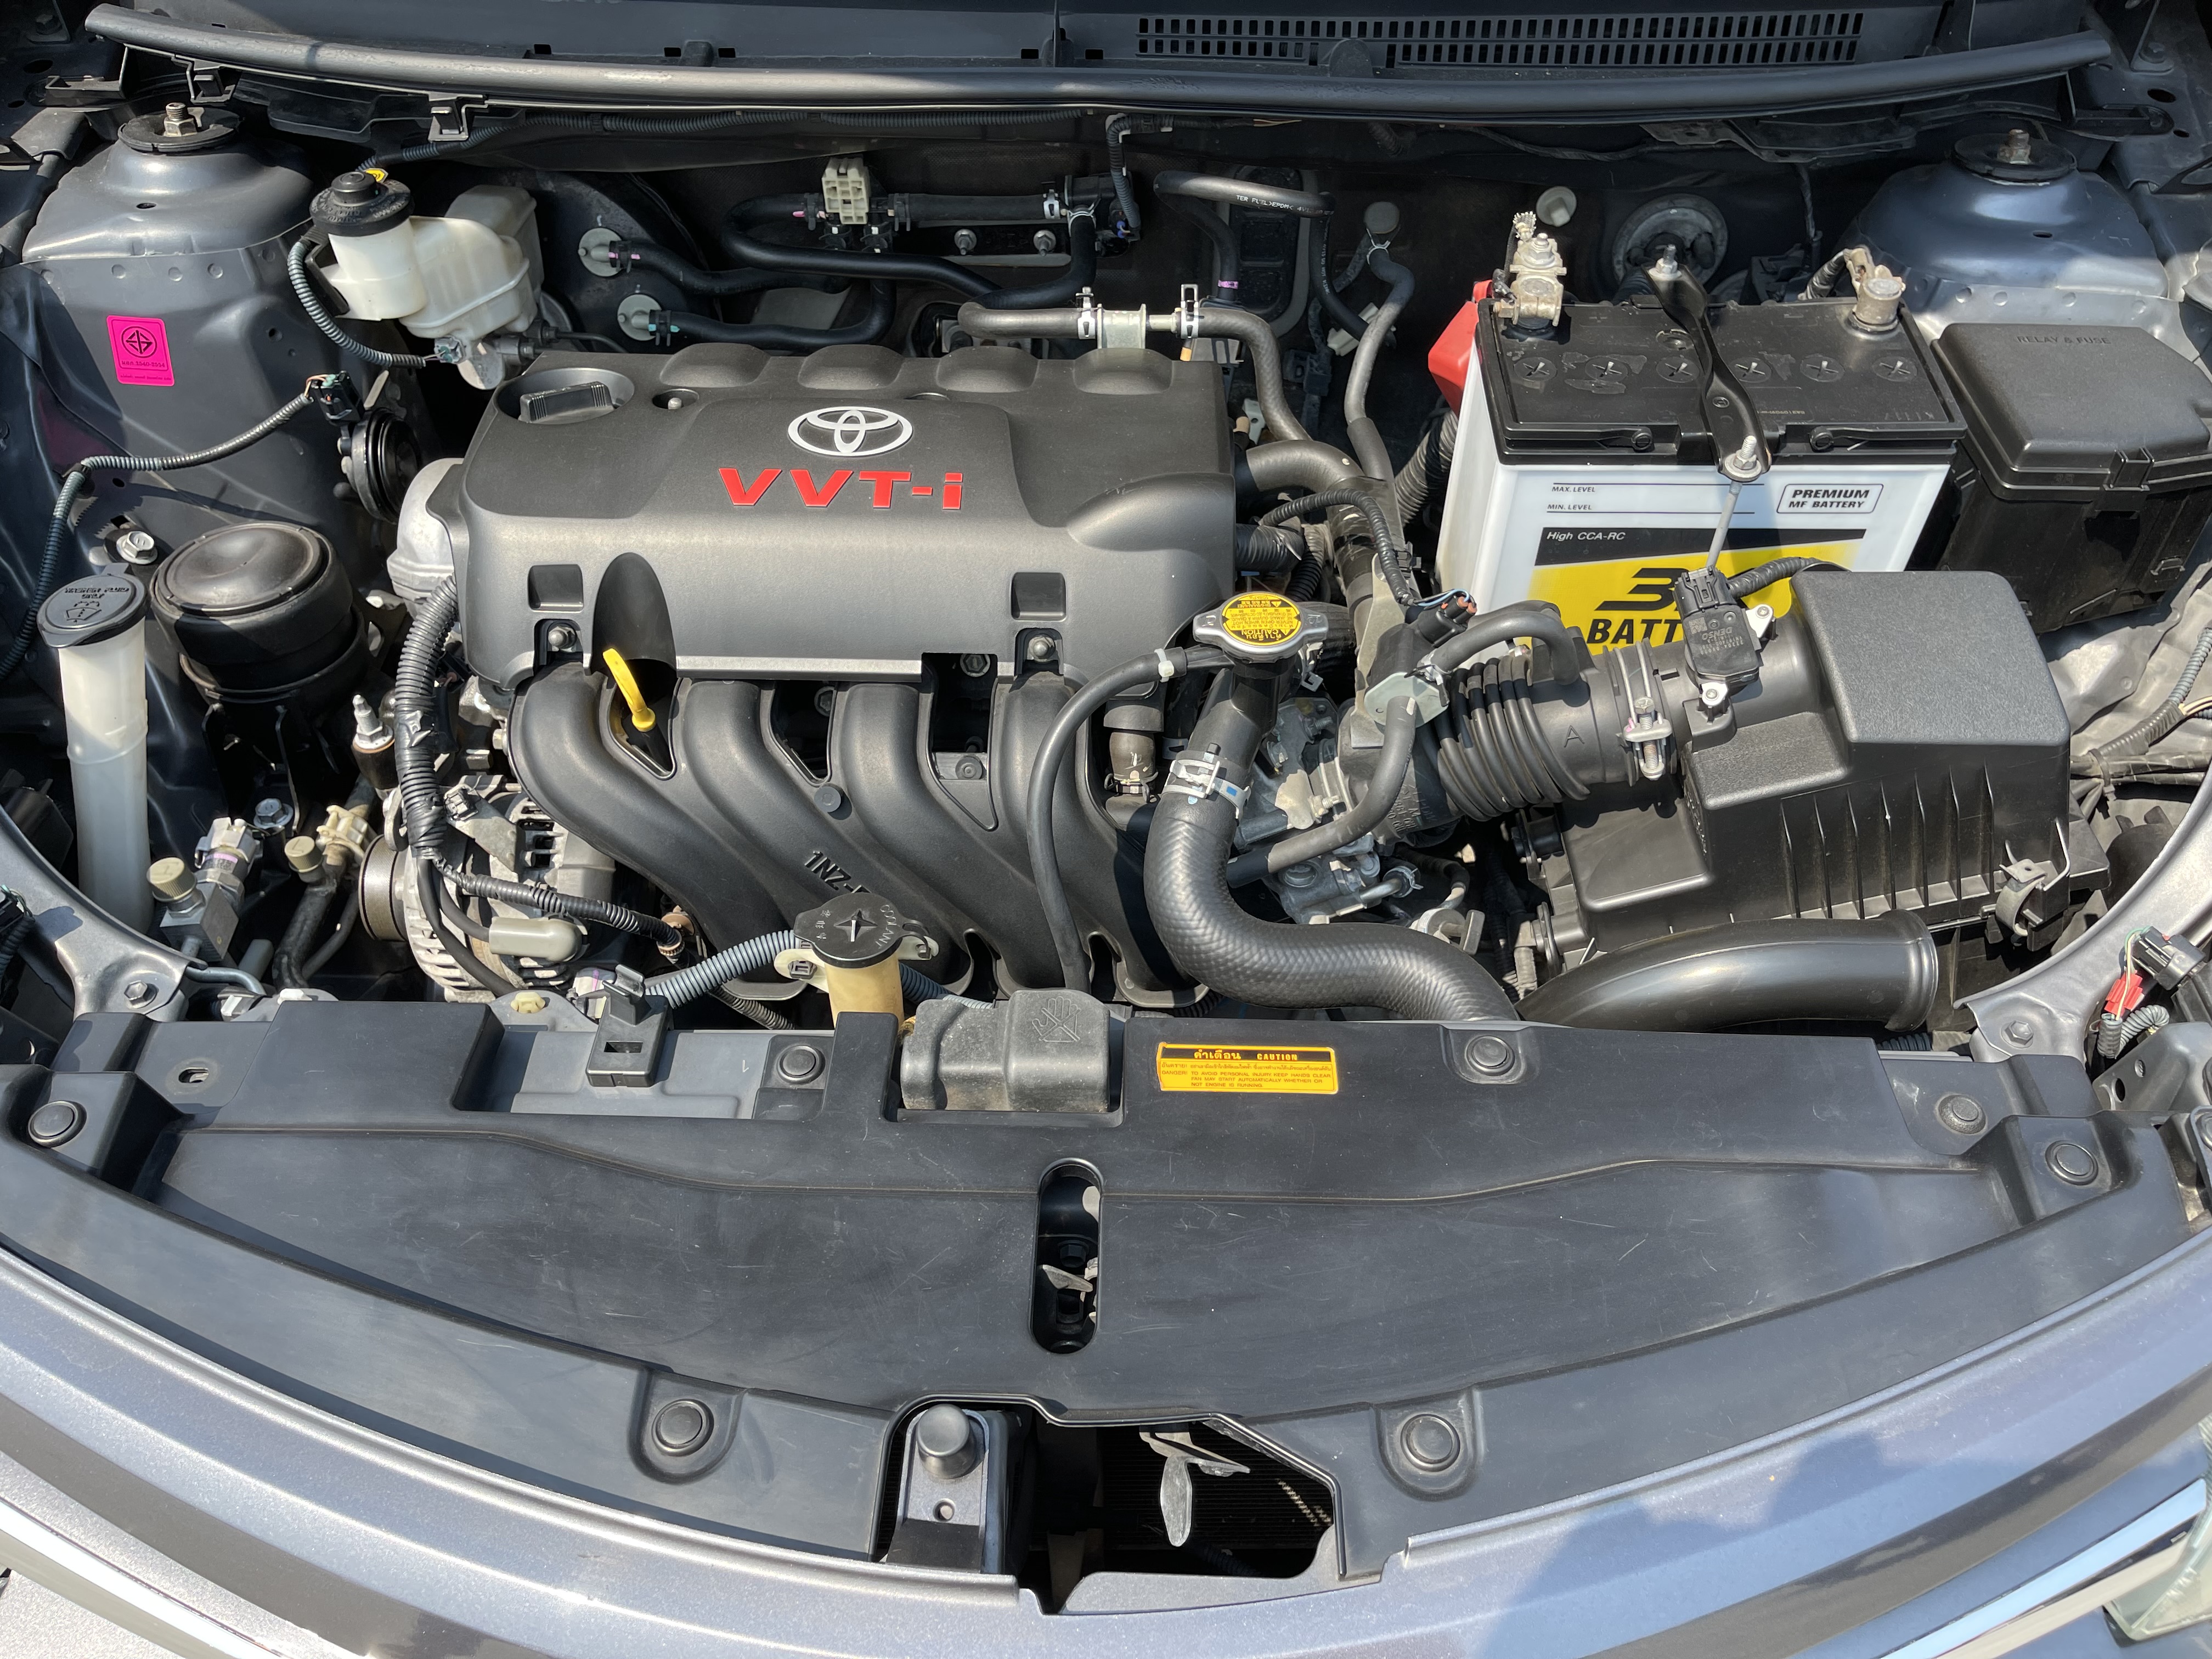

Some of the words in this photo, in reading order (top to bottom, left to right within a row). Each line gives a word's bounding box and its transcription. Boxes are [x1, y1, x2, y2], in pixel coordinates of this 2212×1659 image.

[718, 467, 964, 510] VVT-i
[1791, 489, 1870, 498] PREMIUM
[1546, 532, 1573, 541] High
[1577, 532, 1626, 540] CCA-RC
[1587, 618, 1683, 644] BATT
[1701, 627, 1733, 640] DENSO
[1564, 725, 1585, 748] A
[875, 904, 901, 950] COOLANT
[1193, 1048, 1242, 1060] คำเตือน
[1256, 1053, 1298, 1061] CAUTION
